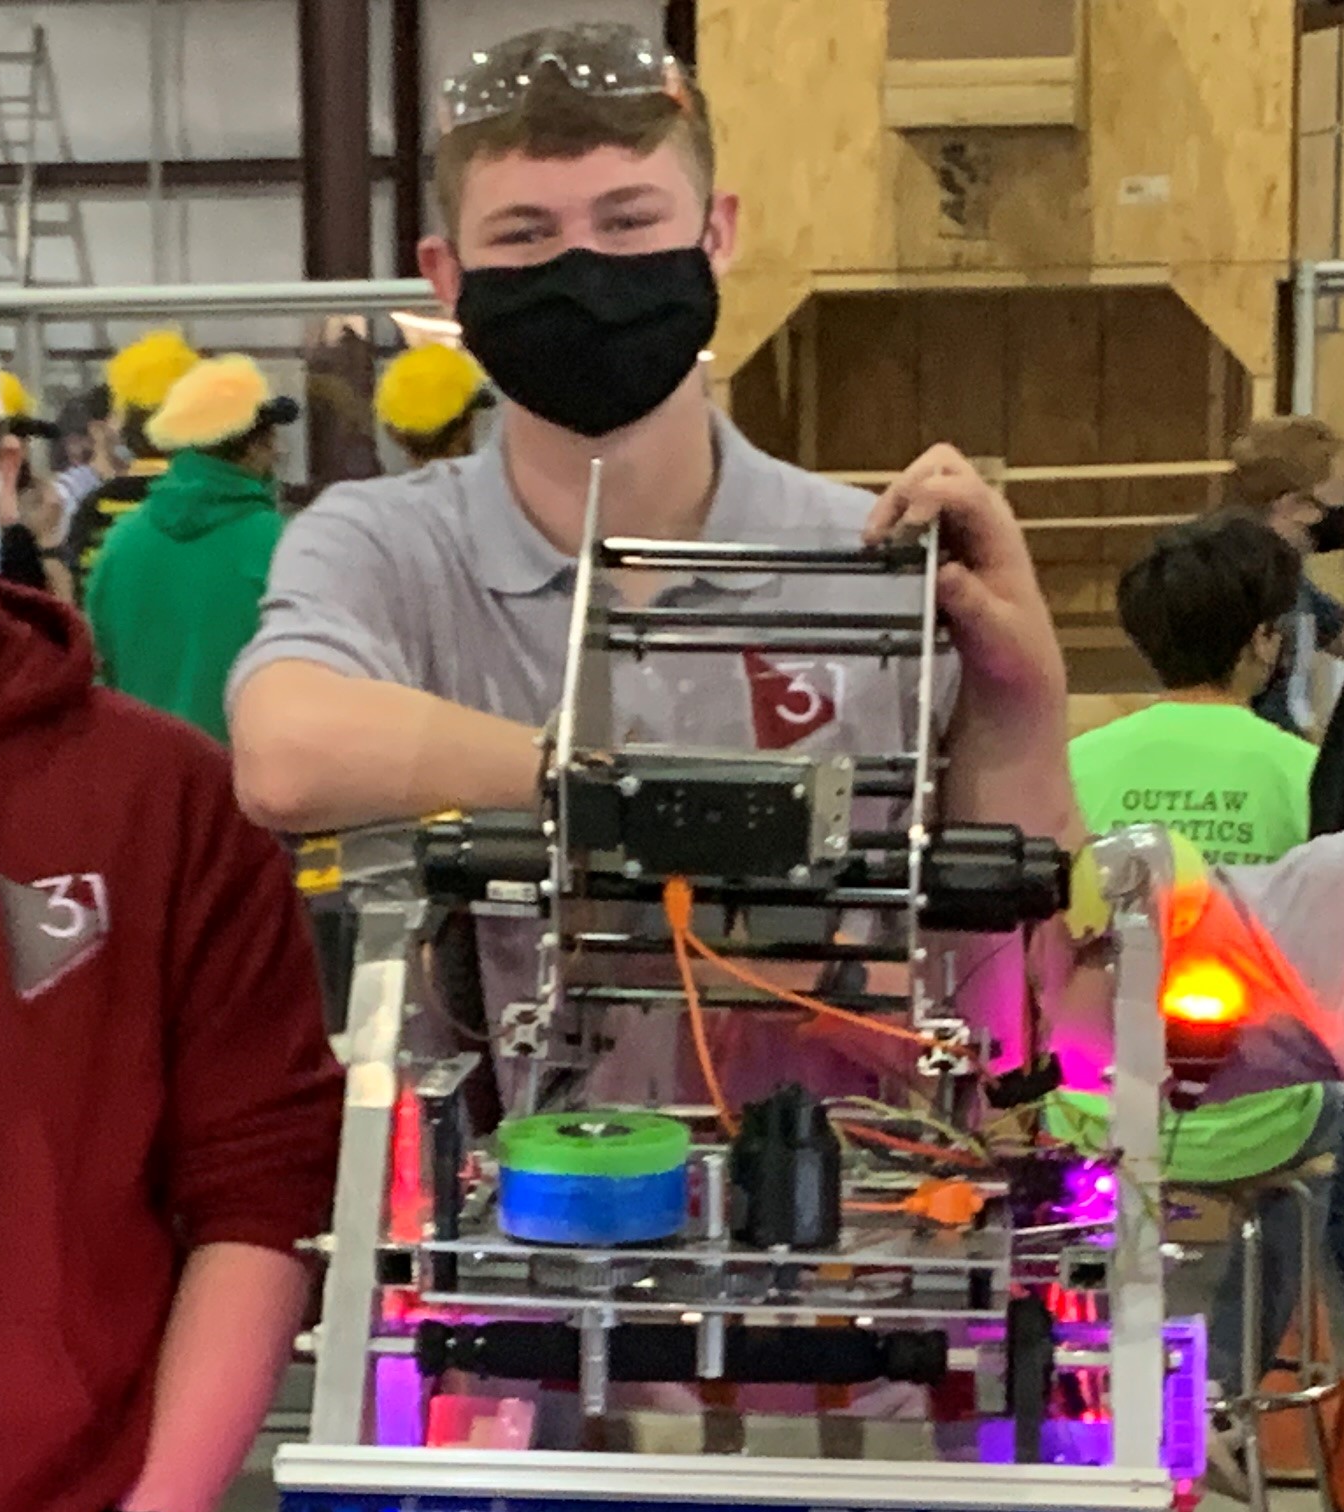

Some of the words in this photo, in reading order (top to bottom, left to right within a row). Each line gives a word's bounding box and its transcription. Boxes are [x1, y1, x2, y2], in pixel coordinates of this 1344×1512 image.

[1121, 789, 1249, 812] OUTLAW
[1111, 818, 1255, 844] OTICS
[32, 872, 110, 938] 31
